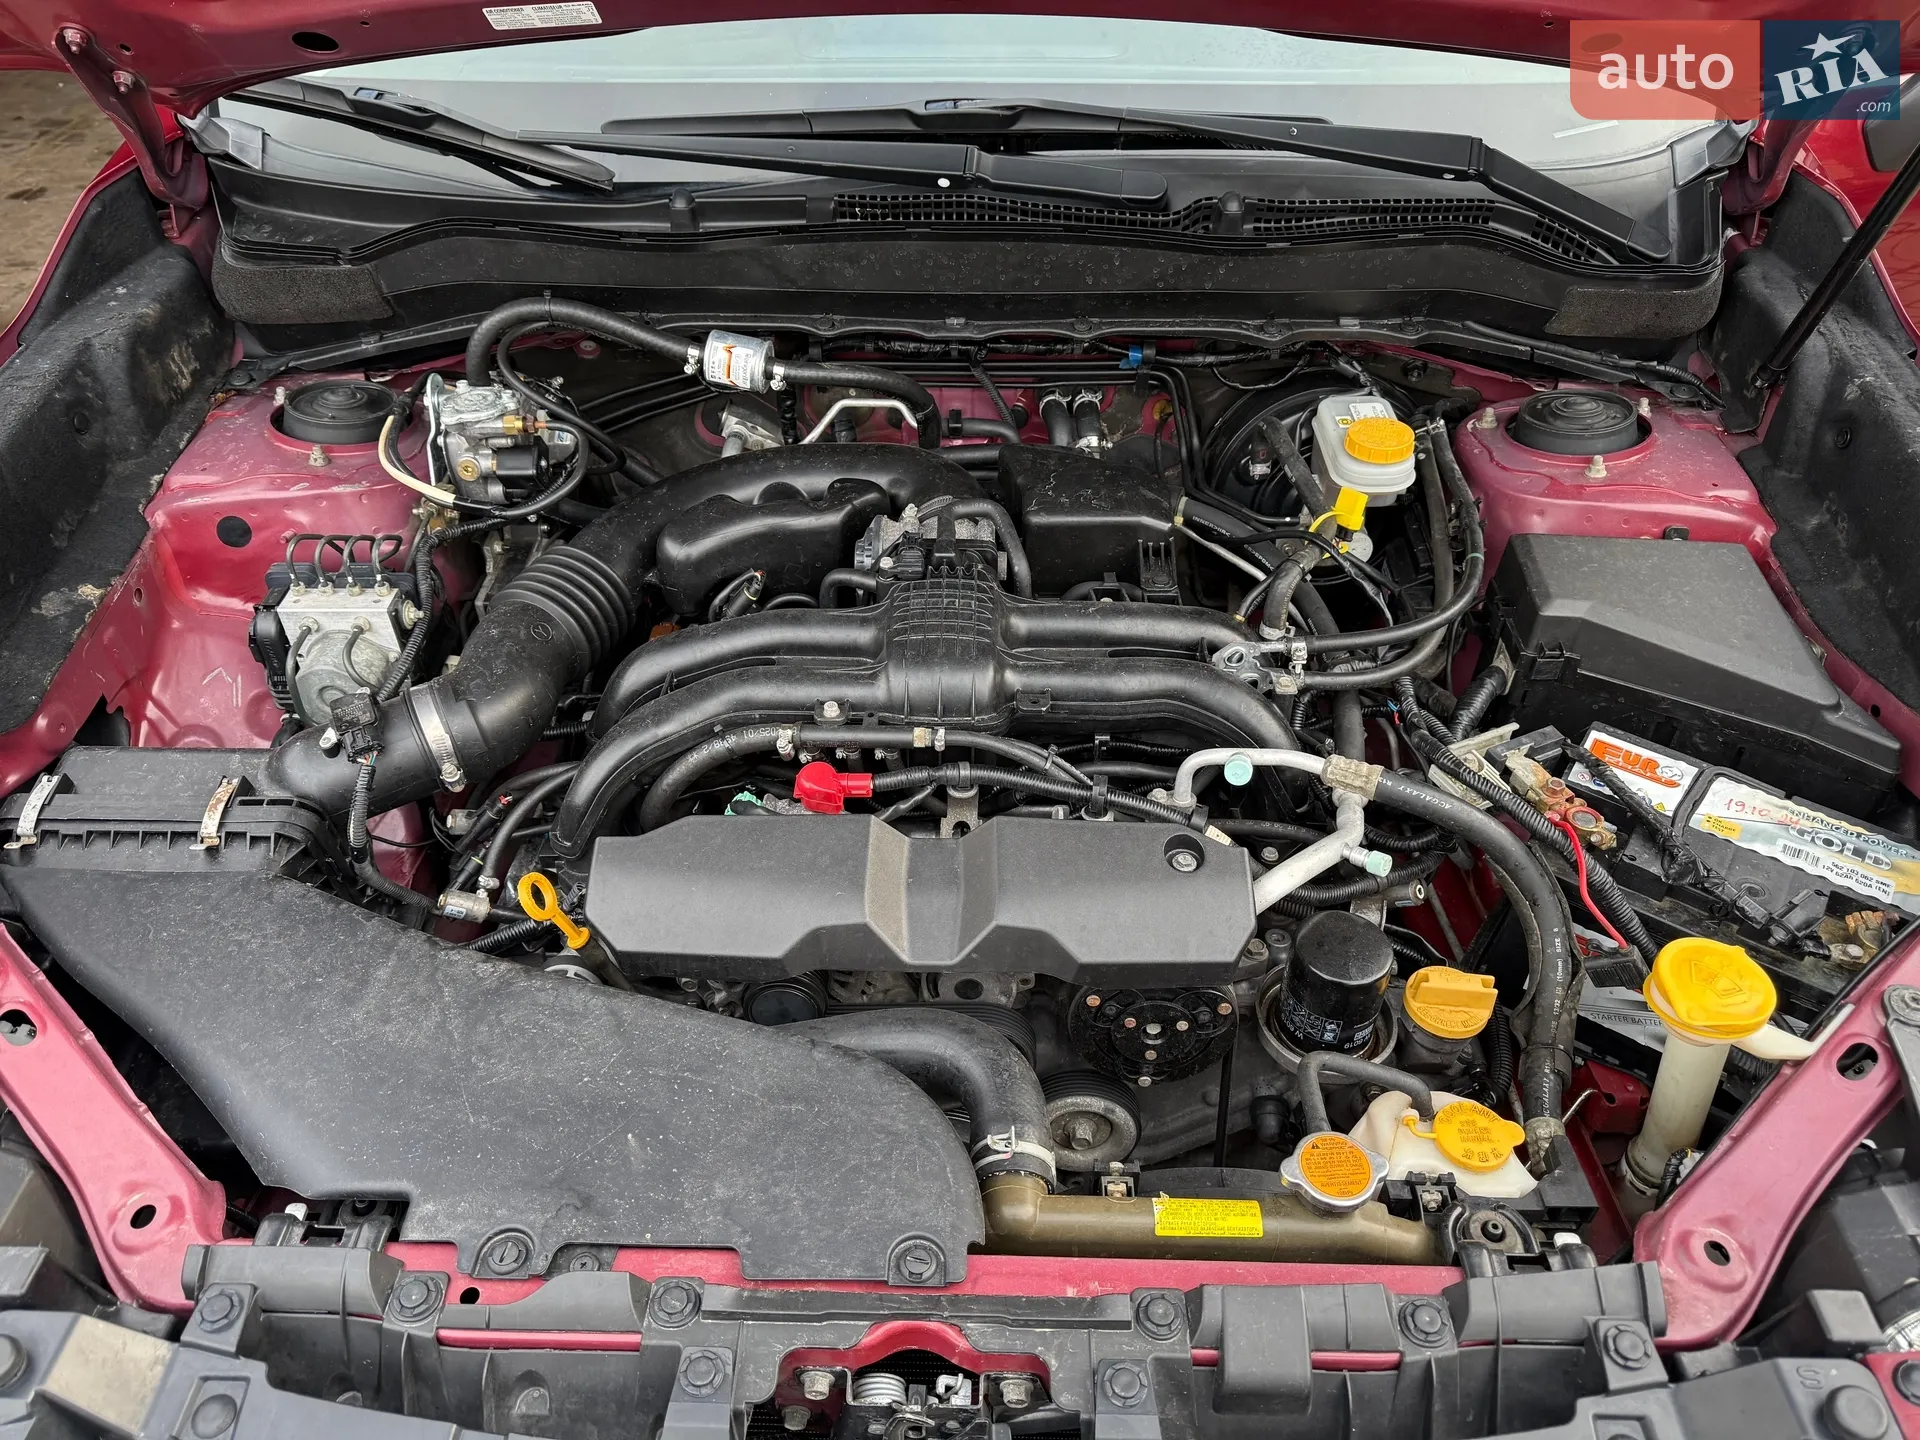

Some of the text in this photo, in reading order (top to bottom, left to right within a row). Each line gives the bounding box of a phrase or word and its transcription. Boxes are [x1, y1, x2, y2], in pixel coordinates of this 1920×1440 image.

[1397, 784, 1453, 810] ACGALAXY
[1787, 807, 1858, 841] ENHANCED
[1858, 834, 1909, 858] POWER
[1788, 825, 1893, 871] GOLD
[1590, 1012, 1629, 1022] STARTER
[1438, 1102, 1500, 1125] COOLANT
